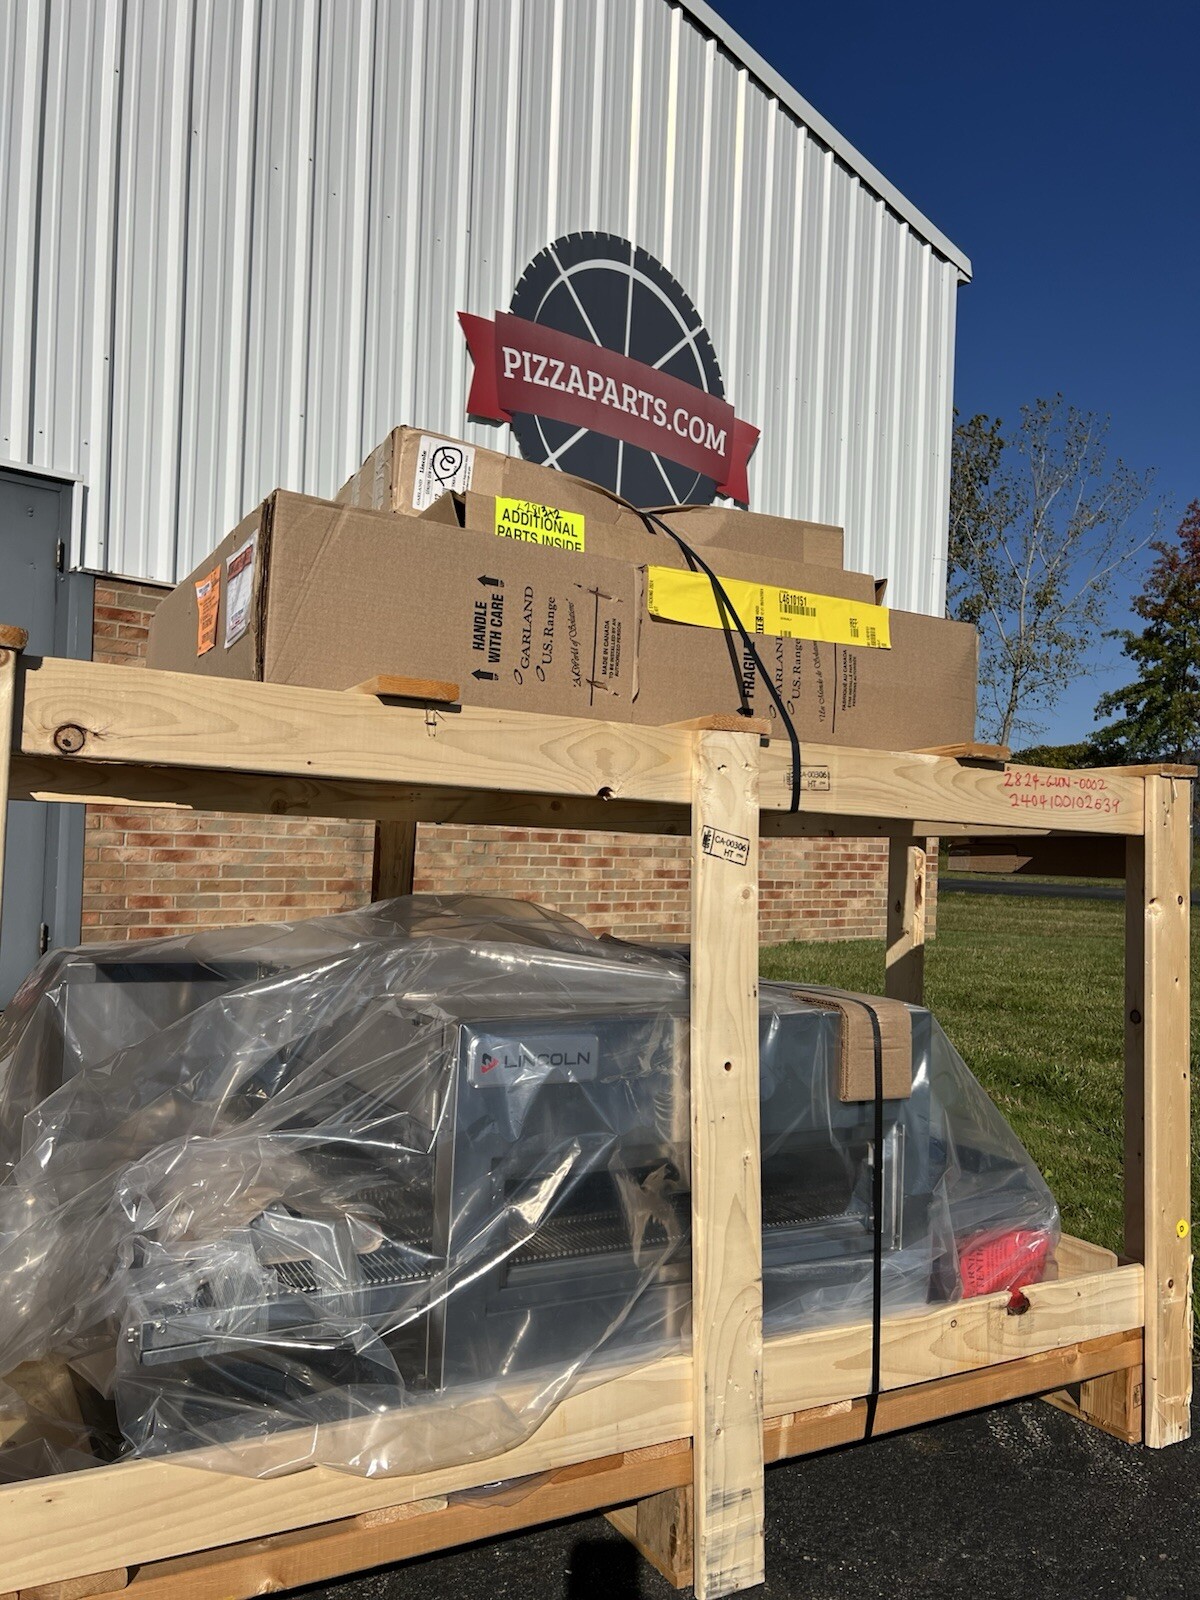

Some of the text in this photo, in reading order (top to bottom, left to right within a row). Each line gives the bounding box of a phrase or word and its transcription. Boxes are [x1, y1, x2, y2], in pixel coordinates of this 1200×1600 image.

[502, 346, 727, 457] PIZZAPARTS.COM
[498, 525, 582, 551] PARTS INSIDE
[502, 508, 578, 537] ADDITIONAL
[472, 601, 487, 651] HANDLE
[488, 594, 504, 663] WITH CARE
[521, 586, 534, 669] GARLAND
[542, 596, 557, 664] U.S. Range
[775, 636, 783, 700] ARLAN
[792, 639, 802, 699] U.S. Range
[800, 771, 828, 779] A-00306
[808, 780, 817, 788] HT
[714, 835, 747, 852] CA-00306
[723, 848, 735, 858] HT
[504, 1052, 591, 1068] LINCOLN
